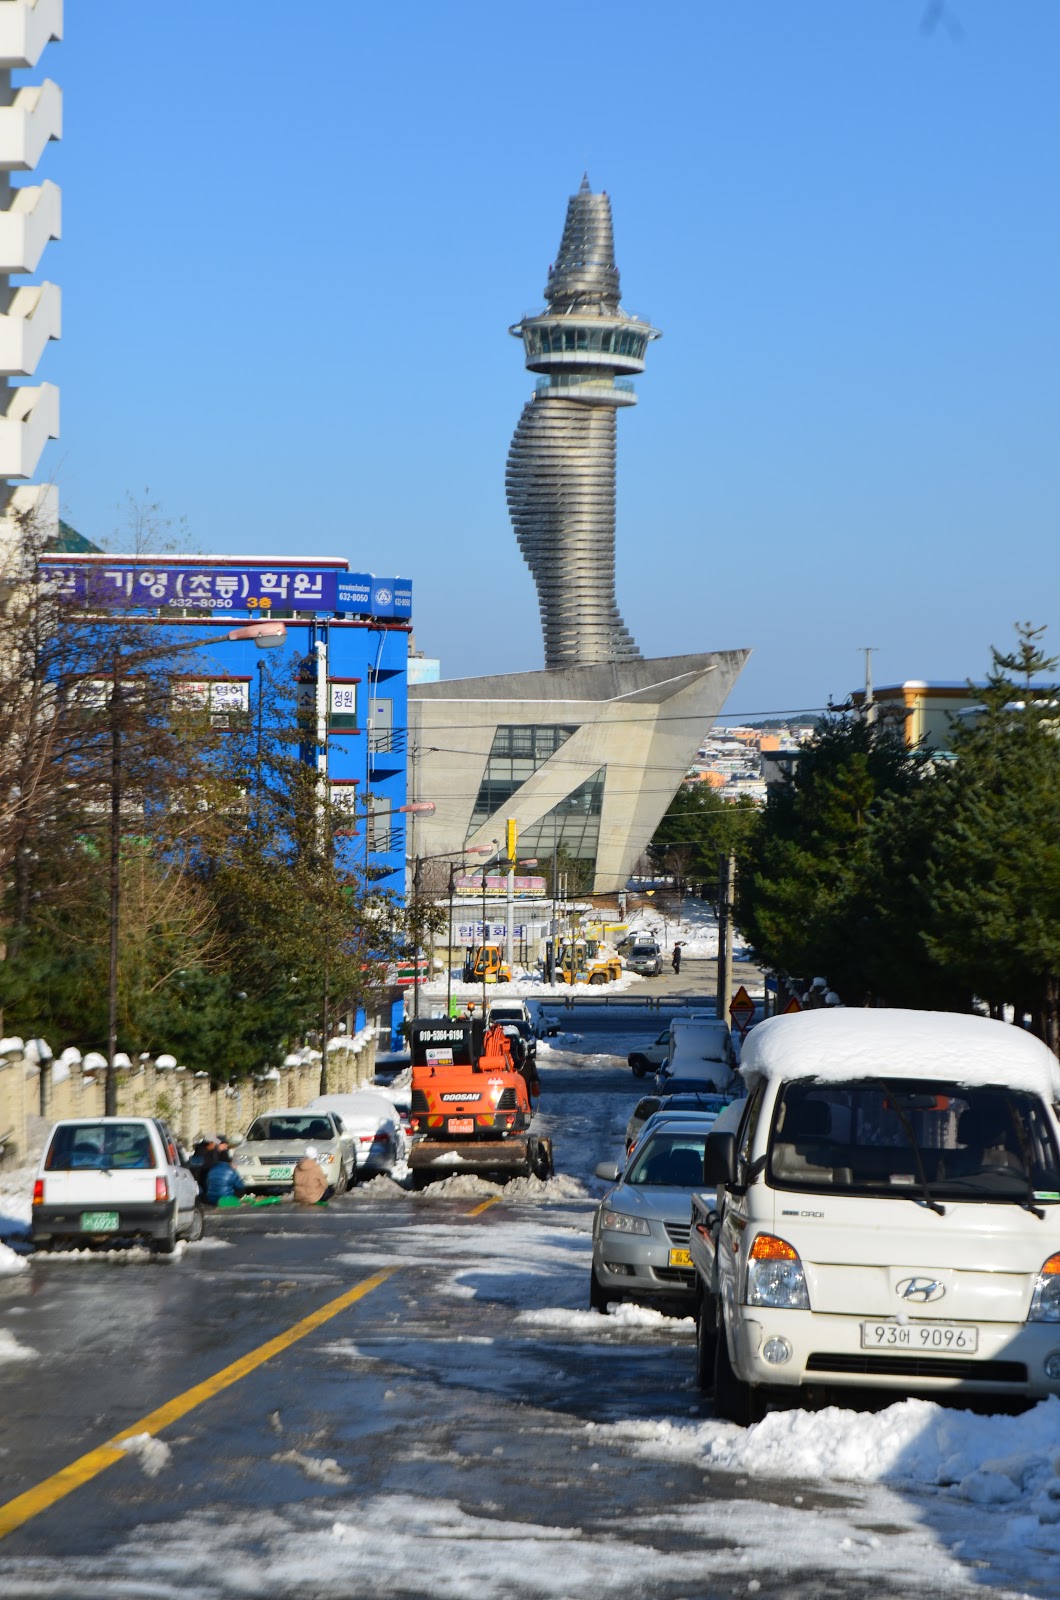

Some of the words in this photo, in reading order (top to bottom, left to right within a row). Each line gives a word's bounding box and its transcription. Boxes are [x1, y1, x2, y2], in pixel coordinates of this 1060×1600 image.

[260, 572, 322, 599] 학원
[168, 597, 233, 608] 632-8050
[246, 597, 272, 608] 3층
[339, 592, 368, 602] 632-8050
[215, 685, 244, 696] 영어
[334, 690, 353, 708] 정원
[443, 1093, 480, 1102] DOOSAN
[94, 1218, 117, 1229] 6923
[875, 1326, 910, 1344] 93어
[920, 1329, 966, 1347] 9096
